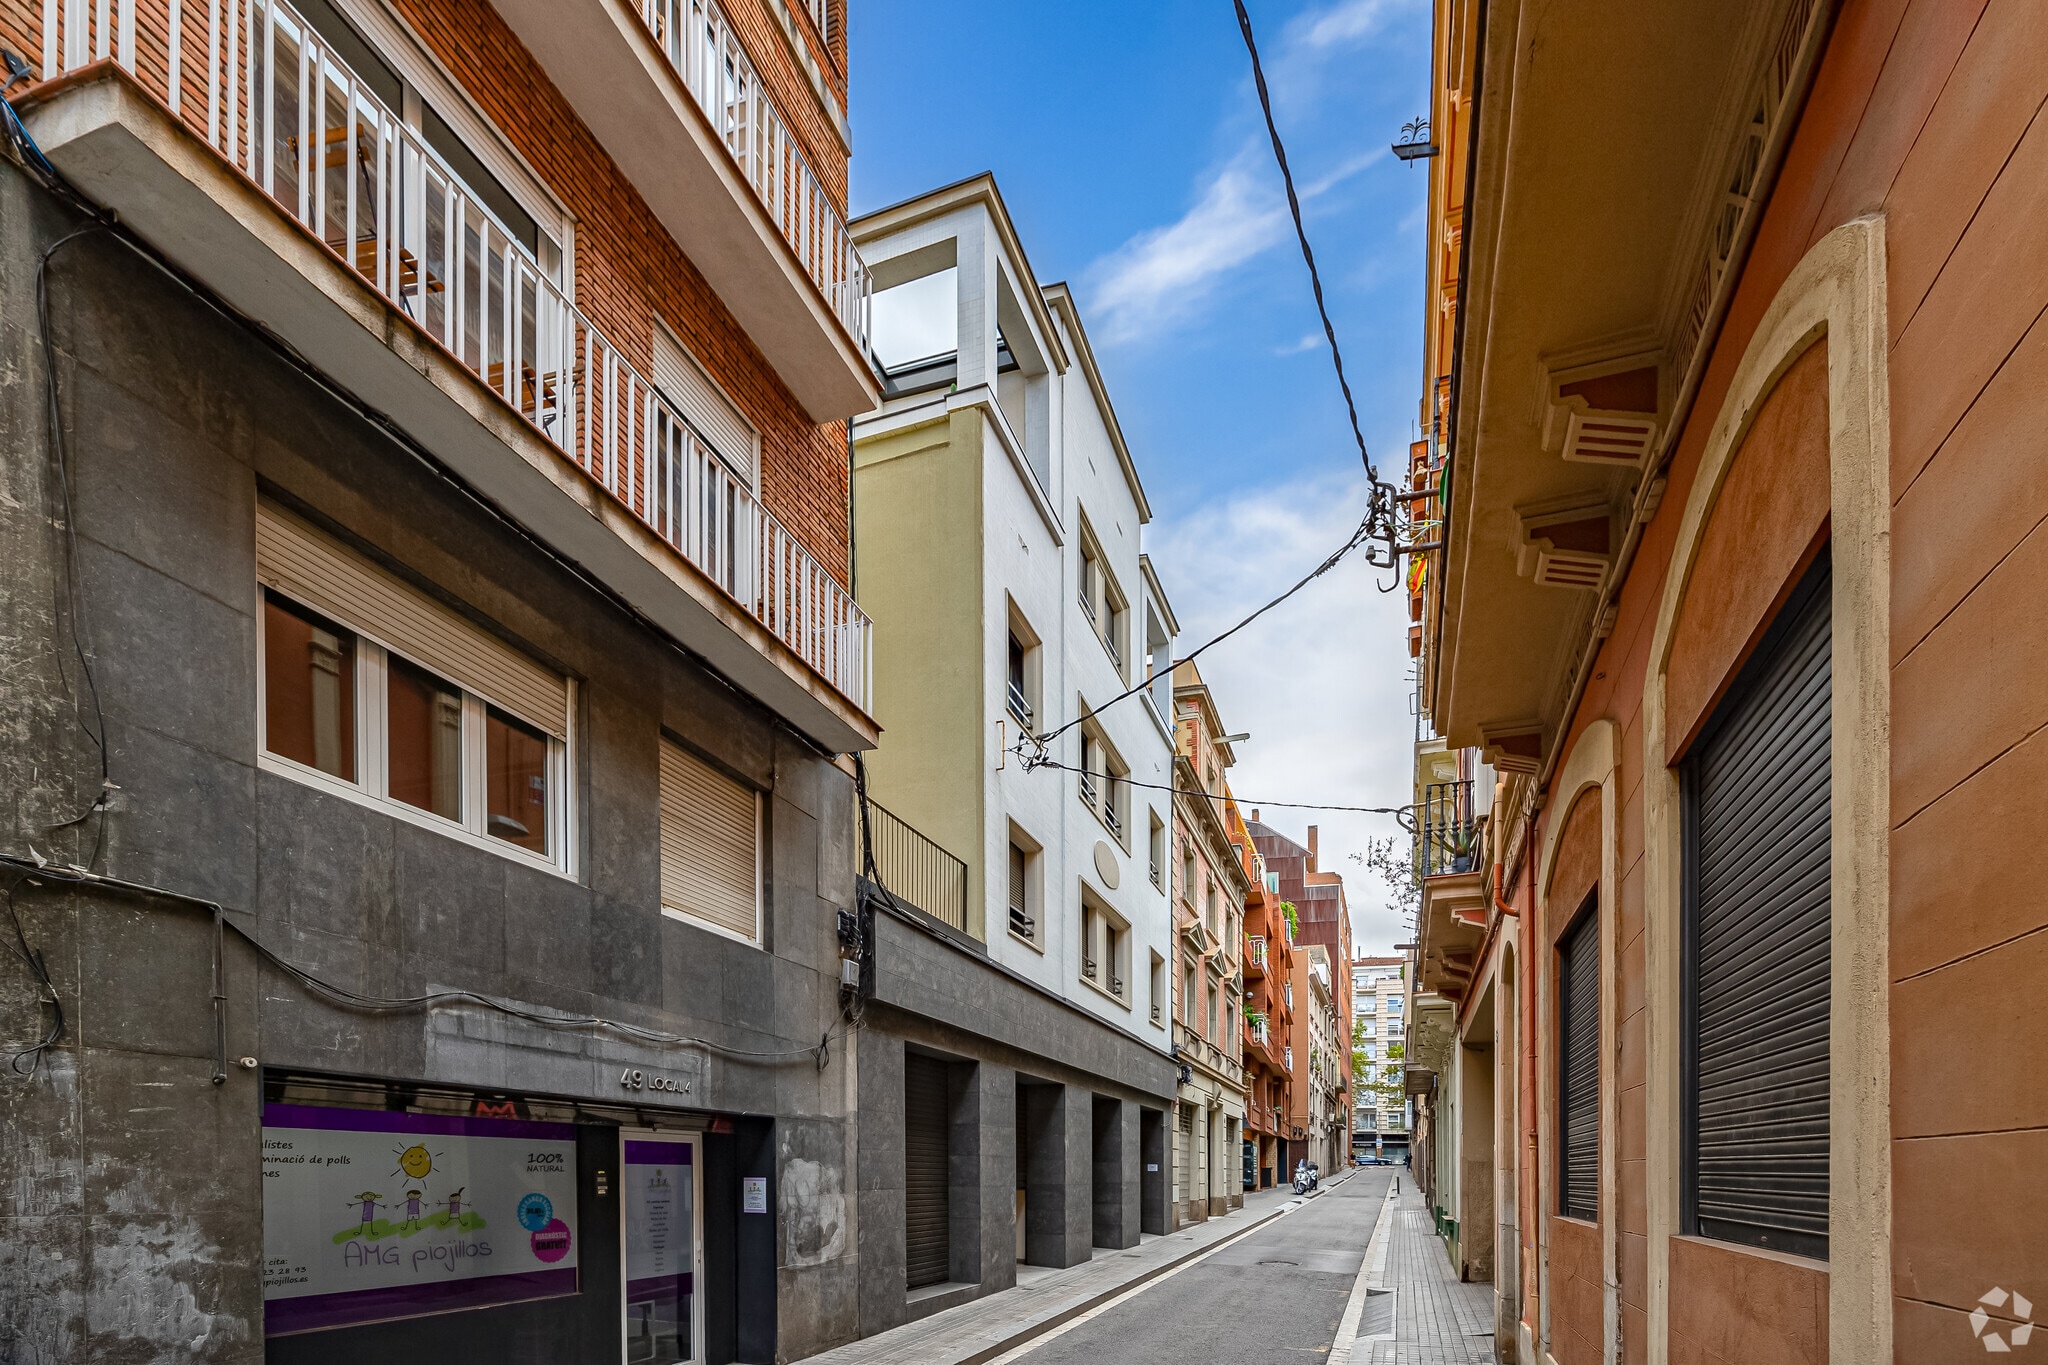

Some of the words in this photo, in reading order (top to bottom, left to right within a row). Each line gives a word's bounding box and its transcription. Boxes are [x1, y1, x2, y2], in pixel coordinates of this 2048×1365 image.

[620, 1068, 643, 1089] 49
[648, 1073, 684, 1093] LOCAL
[685, 1081, 691, 1093] 4
[309, 1155, 322, 1164] de
[326, 1155, 351, 1167] polls
[527, 1153, 564, 1164] 100%
[526, 1165, 565, 1173] NATURAL
[268, 1257, 288, 1266] cita:
[344, 1240, 400, 1268] AMG
[412, 1239, 493, 1273] piojillos
